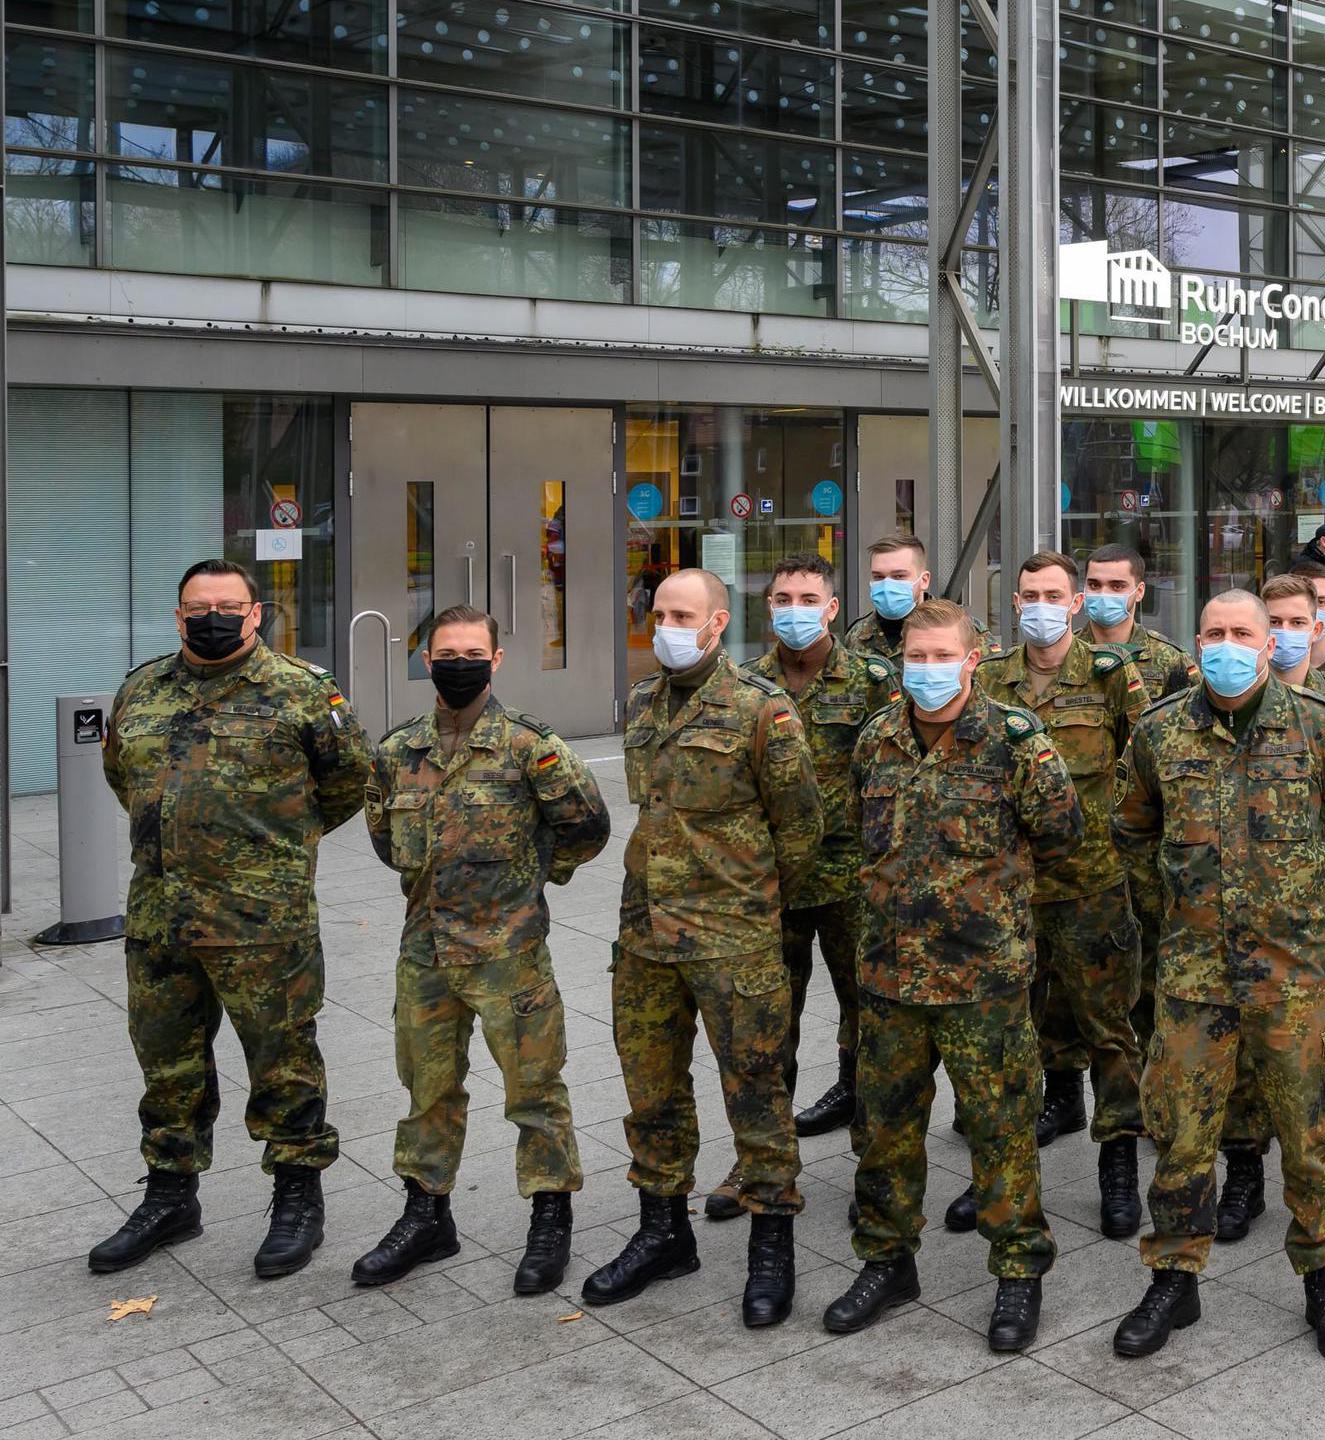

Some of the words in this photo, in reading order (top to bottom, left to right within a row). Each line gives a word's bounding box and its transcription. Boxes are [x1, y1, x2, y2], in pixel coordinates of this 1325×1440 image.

[1181, 322, 1278, 350] BOCHUM
[1060, 385, 1197, 411] WILLKOMMEN
[1211, 392, 1302, 414] WELCOME
